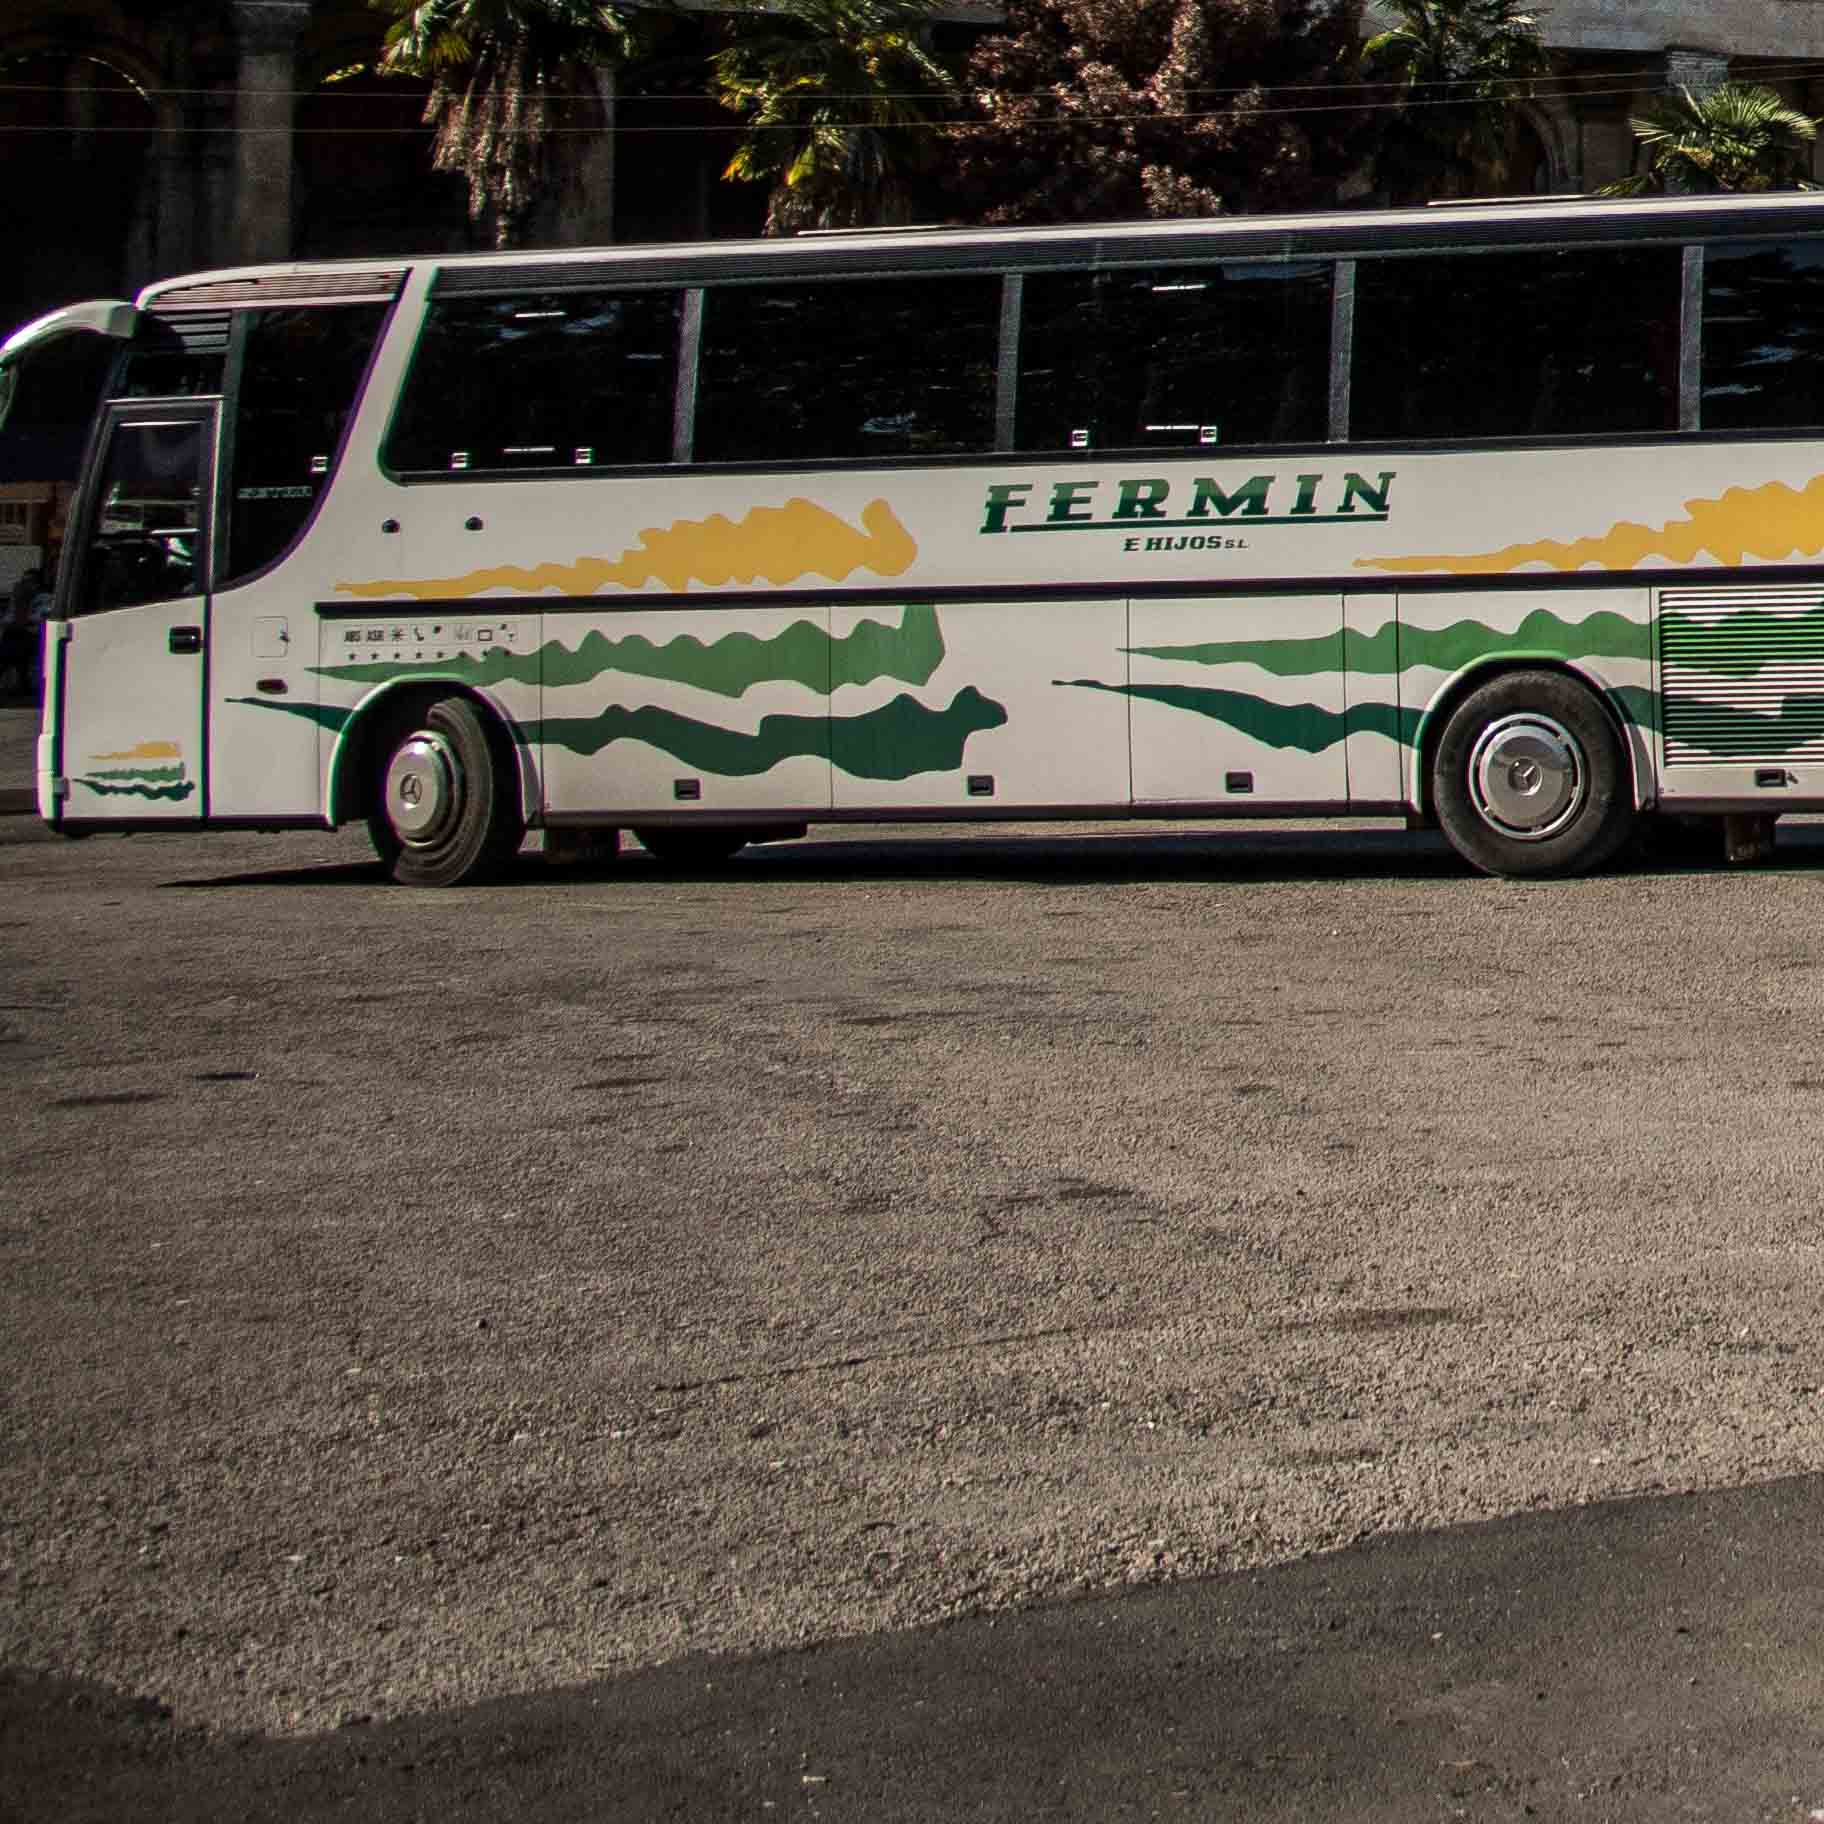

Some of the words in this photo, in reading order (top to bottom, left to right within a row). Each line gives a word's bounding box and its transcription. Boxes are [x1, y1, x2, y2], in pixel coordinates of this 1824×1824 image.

[979, 471, 1397, 533] FERMIN
[1123, 537, 1140, 551] E
[1144, 536, 1222, 551] HIJOS
